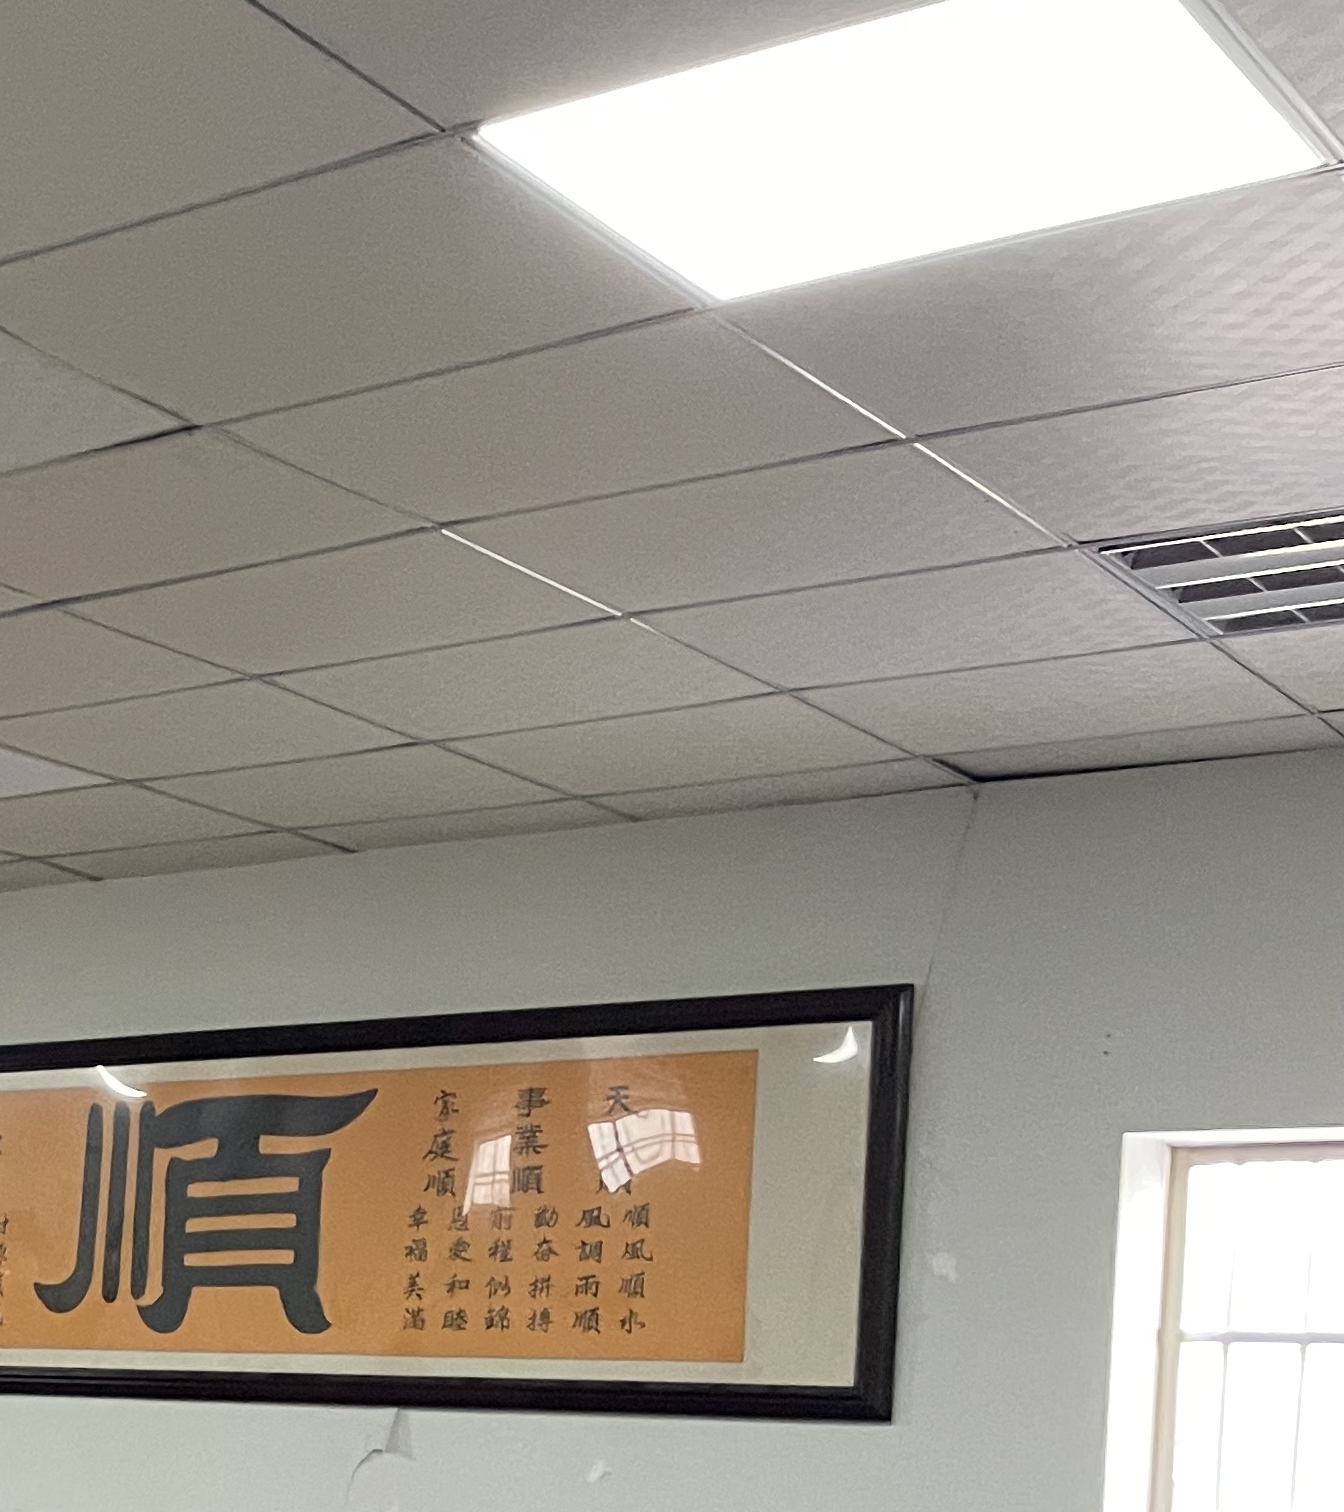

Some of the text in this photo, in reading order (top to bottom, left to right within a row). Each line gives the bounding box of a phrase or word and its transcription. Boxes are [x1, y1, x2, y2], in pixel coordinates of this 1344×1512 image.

[422, 1090, 460, 1197] 家庭順
[511, 1086, 551, 1196] 事業順
[33, 1088, 380, 1336] 順
[571, 1205, 611, 1334] 風調雨順
[618, 1202, 654, 1334] 順風順水
